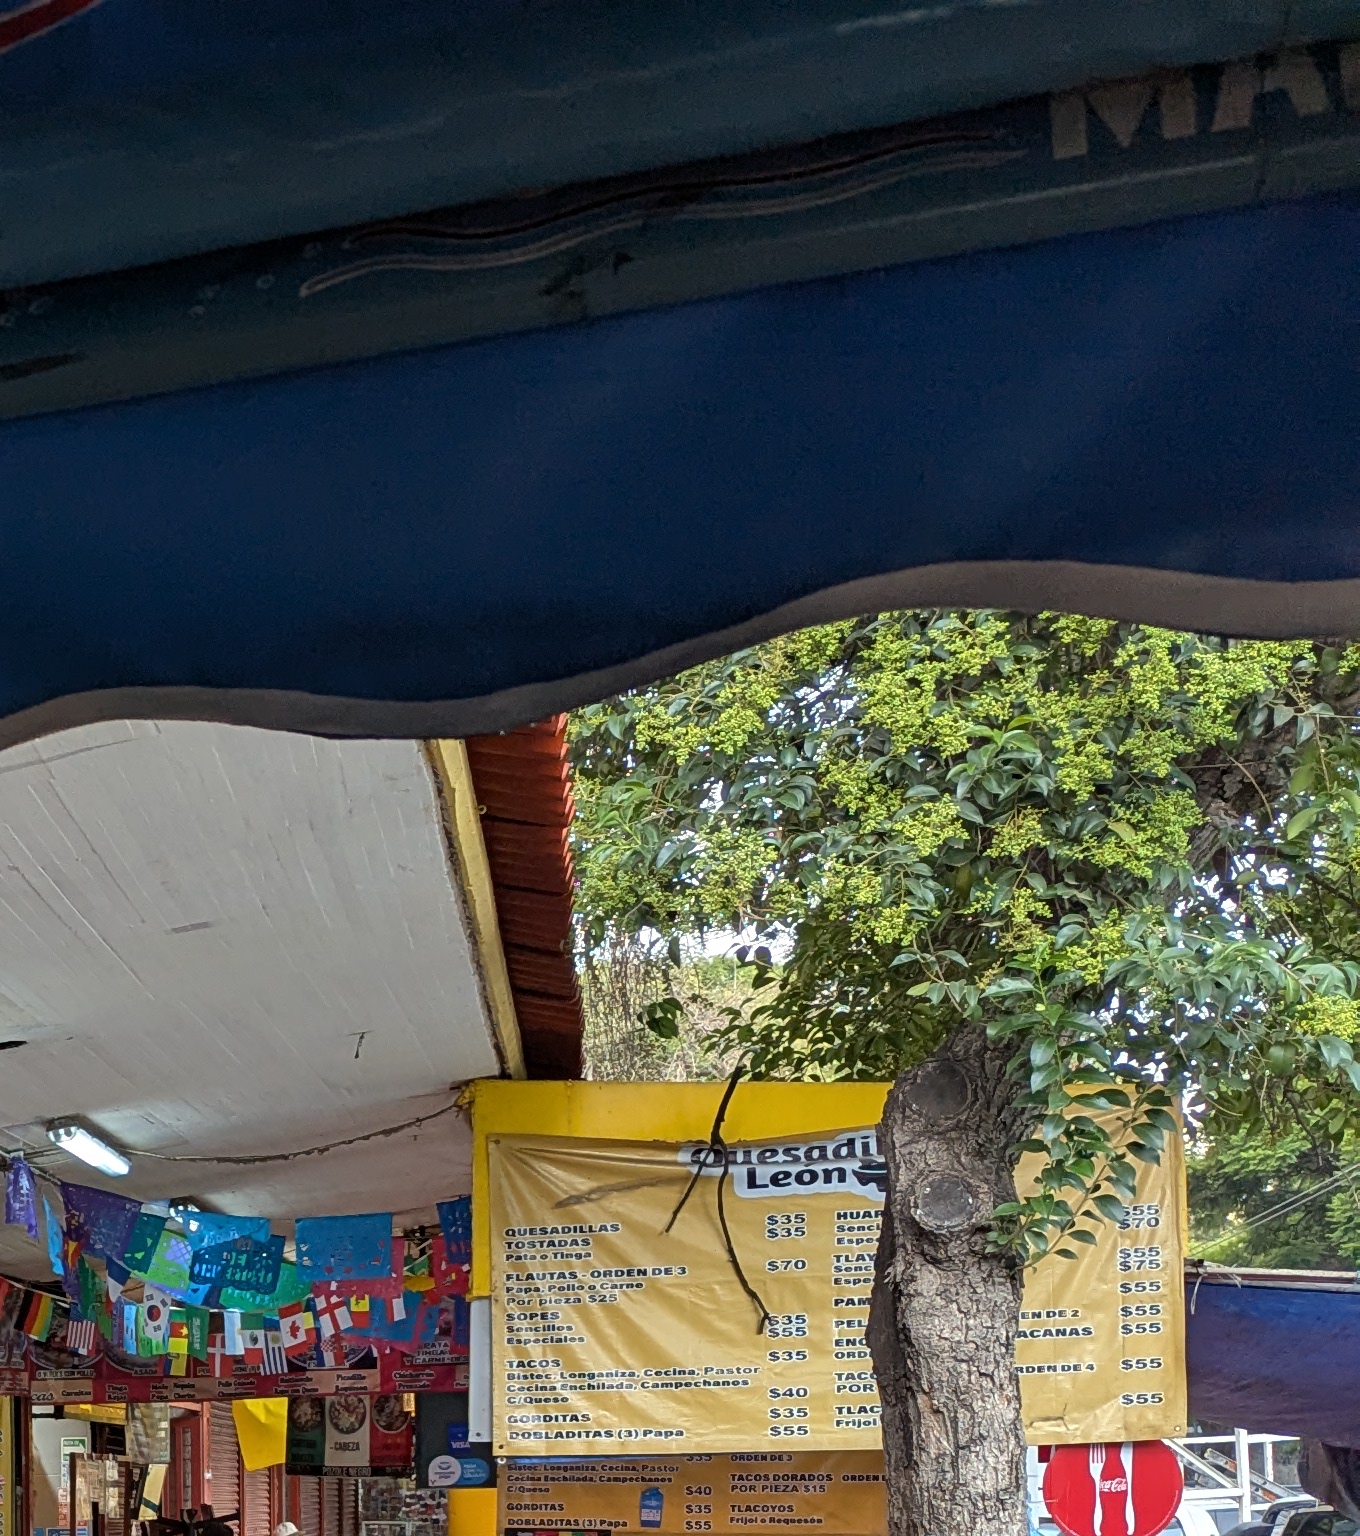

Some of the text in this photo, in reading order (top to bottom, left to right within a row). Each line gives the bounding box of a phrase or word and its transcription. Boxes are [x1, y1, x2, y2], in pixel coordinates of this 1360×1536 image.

[746, 1161, 847, 1190] León
[766, 1213, 806, 1227] $35
[1118, 1216, 1160, 1230] $70
[505, 1223, 620, 1237] QUESADILLAS
[766, 1226, 806, 1239] $35
[505, 1238, 591, 1250] TOSTADAS
[505, 1253, 537, 1262] Pata
[552, 1251, 592, 1261] Tinga
[833, 1253, 876, 1264] TLAY
[1119, 1246, 1161, 1260] $55
[767, 1259, 807, 1272] $70
[1119, 1258, 1161, 1273] $75
[506, 1265, 687, 1282] FLAUTAS ORDEN DE 3
[506, 1286, 544, 1296] Papa,
[548, 1283, 585, 1293] Pollo
[599, 1281, 644, 1291] Carne
[1119, 1281, 1161, 1294] $55
[506, 1294, 618, 1308] Por pieza $25
[506, 1311, 561, 1322] SOPES
[1045, 1309, 1080, 1318] DE 2
[1120, 1304, 1161, 1318] $55
[768, 1314, 808, 1327] $35
[506, 1324, 574, 1334] Sencillos
[768, 1326, 808, 1339] $55
[1016, 1327, 1094, 1339] ACANAS
[1120, 1322, 1161, 1336] $55
[506, 1335, 586, 1346] Especiales
[768, 1350, 808, 1363] $35
[506, 1359, 561, 1370] TACOS
[1015, 1362, 1095, 1374] RDEN DE 4
[1120, 1357, 1162, 1371] $55
[560, 1370, 641, 1381] Longaniza,
[643, 1368, 700, 1379] Cecina,
[703, 1366, 761, 1377] Pastor
[507, 1384, 556, 1393] Cecina
[640, 1379, 750, 1390] Campechanos
[836, 1384, 875, 1394] POR
[769, 1387, 809, 1400] $40
[1120, 1392, 1164, 1406] $55
[507, 1396, 570, 1405] C/Queso
[769, 1407, 809, 1419] $35
[835, 1405, 881, 1415] TLAC
[507, 1413, 591, 1424] GORDITAS
[836, 1418, 878, 1429] Frijol
[509, 1429, 685, 1440] DOBLADITAS (3) Papa
[769, 1425, 809, 1438] $55
[642, 1464, 680, 1473] Pastor
[599, 1475, 673, 1485] Campechanos
[730, 1473, 880, 1482] TACOS DORADOS ORDEN
[685, 1485, 712, 1496] $40
[731, 1484, 827, 1493] POR PIEZA $15
[507, 1503, 565, 1512] GORDITAS
[685, 1504, 712, 1514] $35
[730, 1504, 795, 1513] TLACOYOS
[507, 1518, 628, 1528] DOBLADITAS (3) Papa
[685, 1521, 712, 1531] $55
[730, 1517, 758, 1525] Frijol
